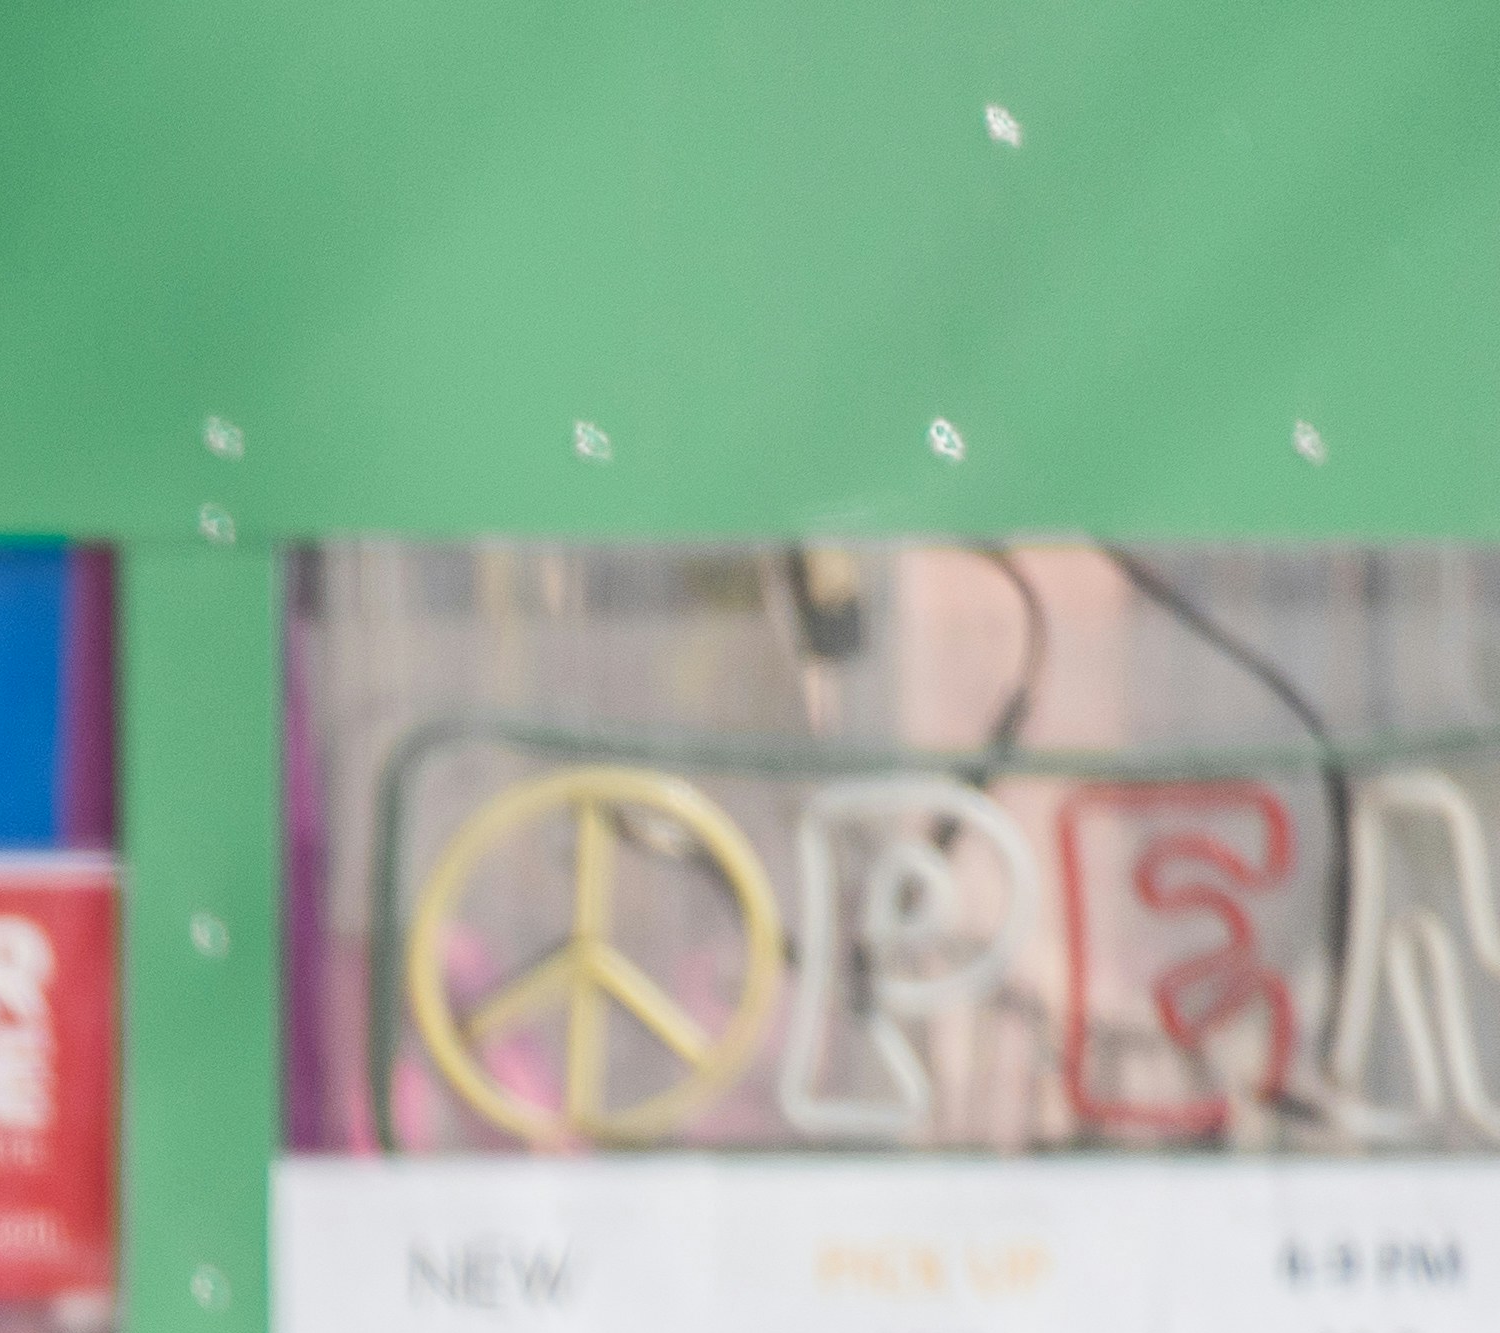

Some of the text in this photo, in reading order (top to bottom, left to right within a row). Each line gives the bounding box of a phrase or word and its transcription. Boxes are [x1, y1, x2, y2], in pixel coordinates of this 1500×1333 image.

[408, 1241, 576, 1309] NEW
[817, 1243, 1049, 1292] PICK UP
[1375, 1239, 1466, 1284] PM
